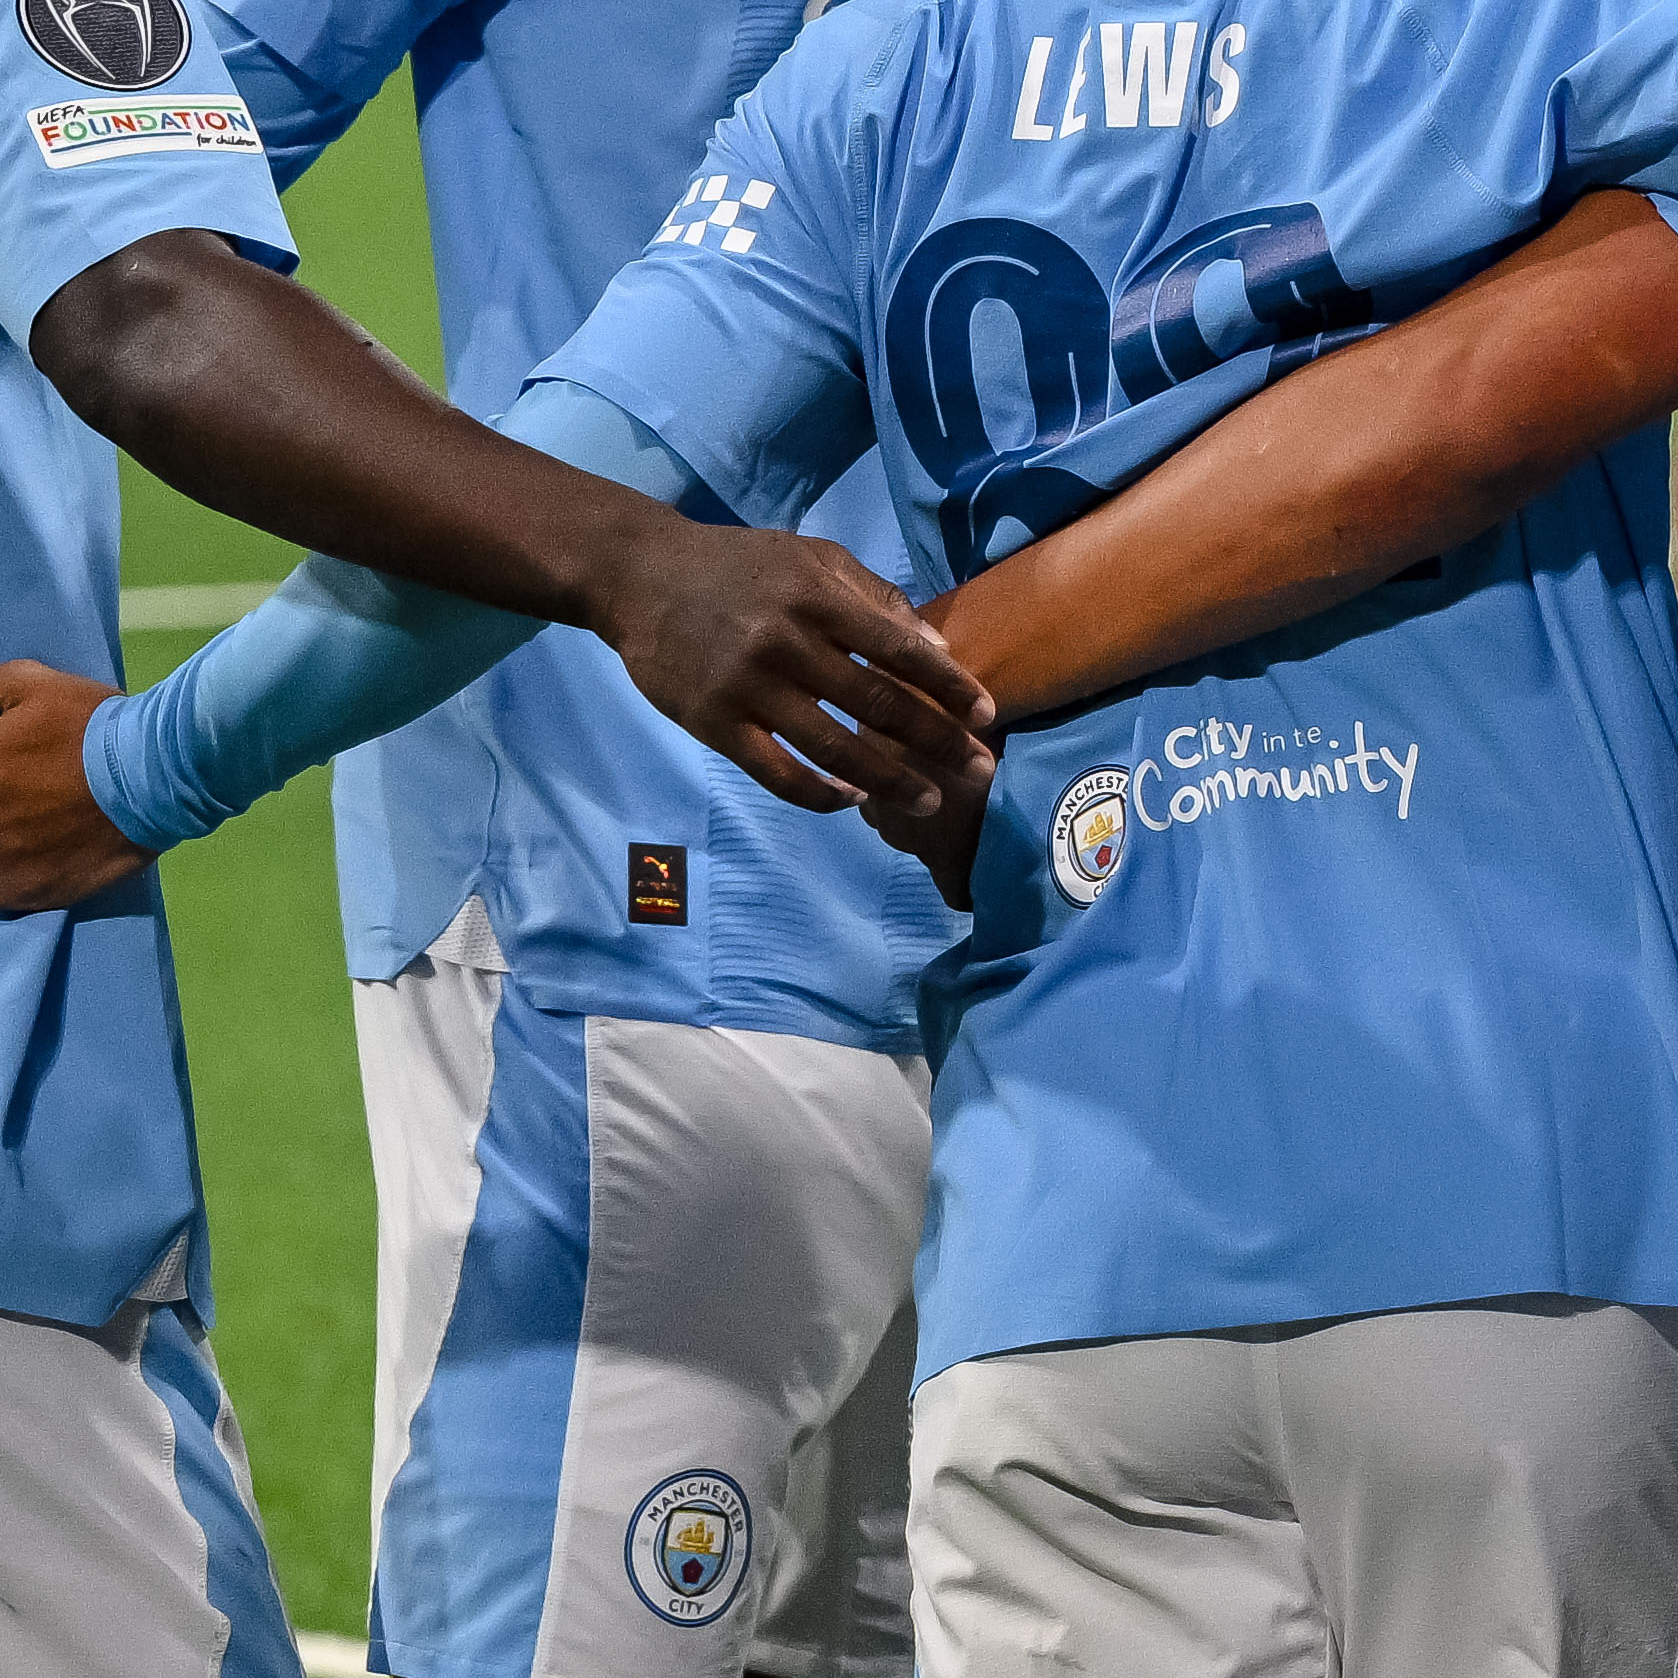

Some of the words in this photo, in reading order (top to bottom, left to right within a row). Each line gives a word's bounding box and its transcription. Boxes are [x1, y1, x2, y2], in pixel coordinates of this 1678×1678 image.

[1011, 21, 1247, 141] LEWS
[36, 104, 86, 126] UEFA
[40, 111, 251, 147] FOUNDATION
[1163, 717, 1253, 769] City
[1261, 731, 1286, 753] in
[1132, 721, 1419, 832] Community
[647, 1482, 744, 1534] MANCHESTER
[668, 1599, 705, 1615] CITY
